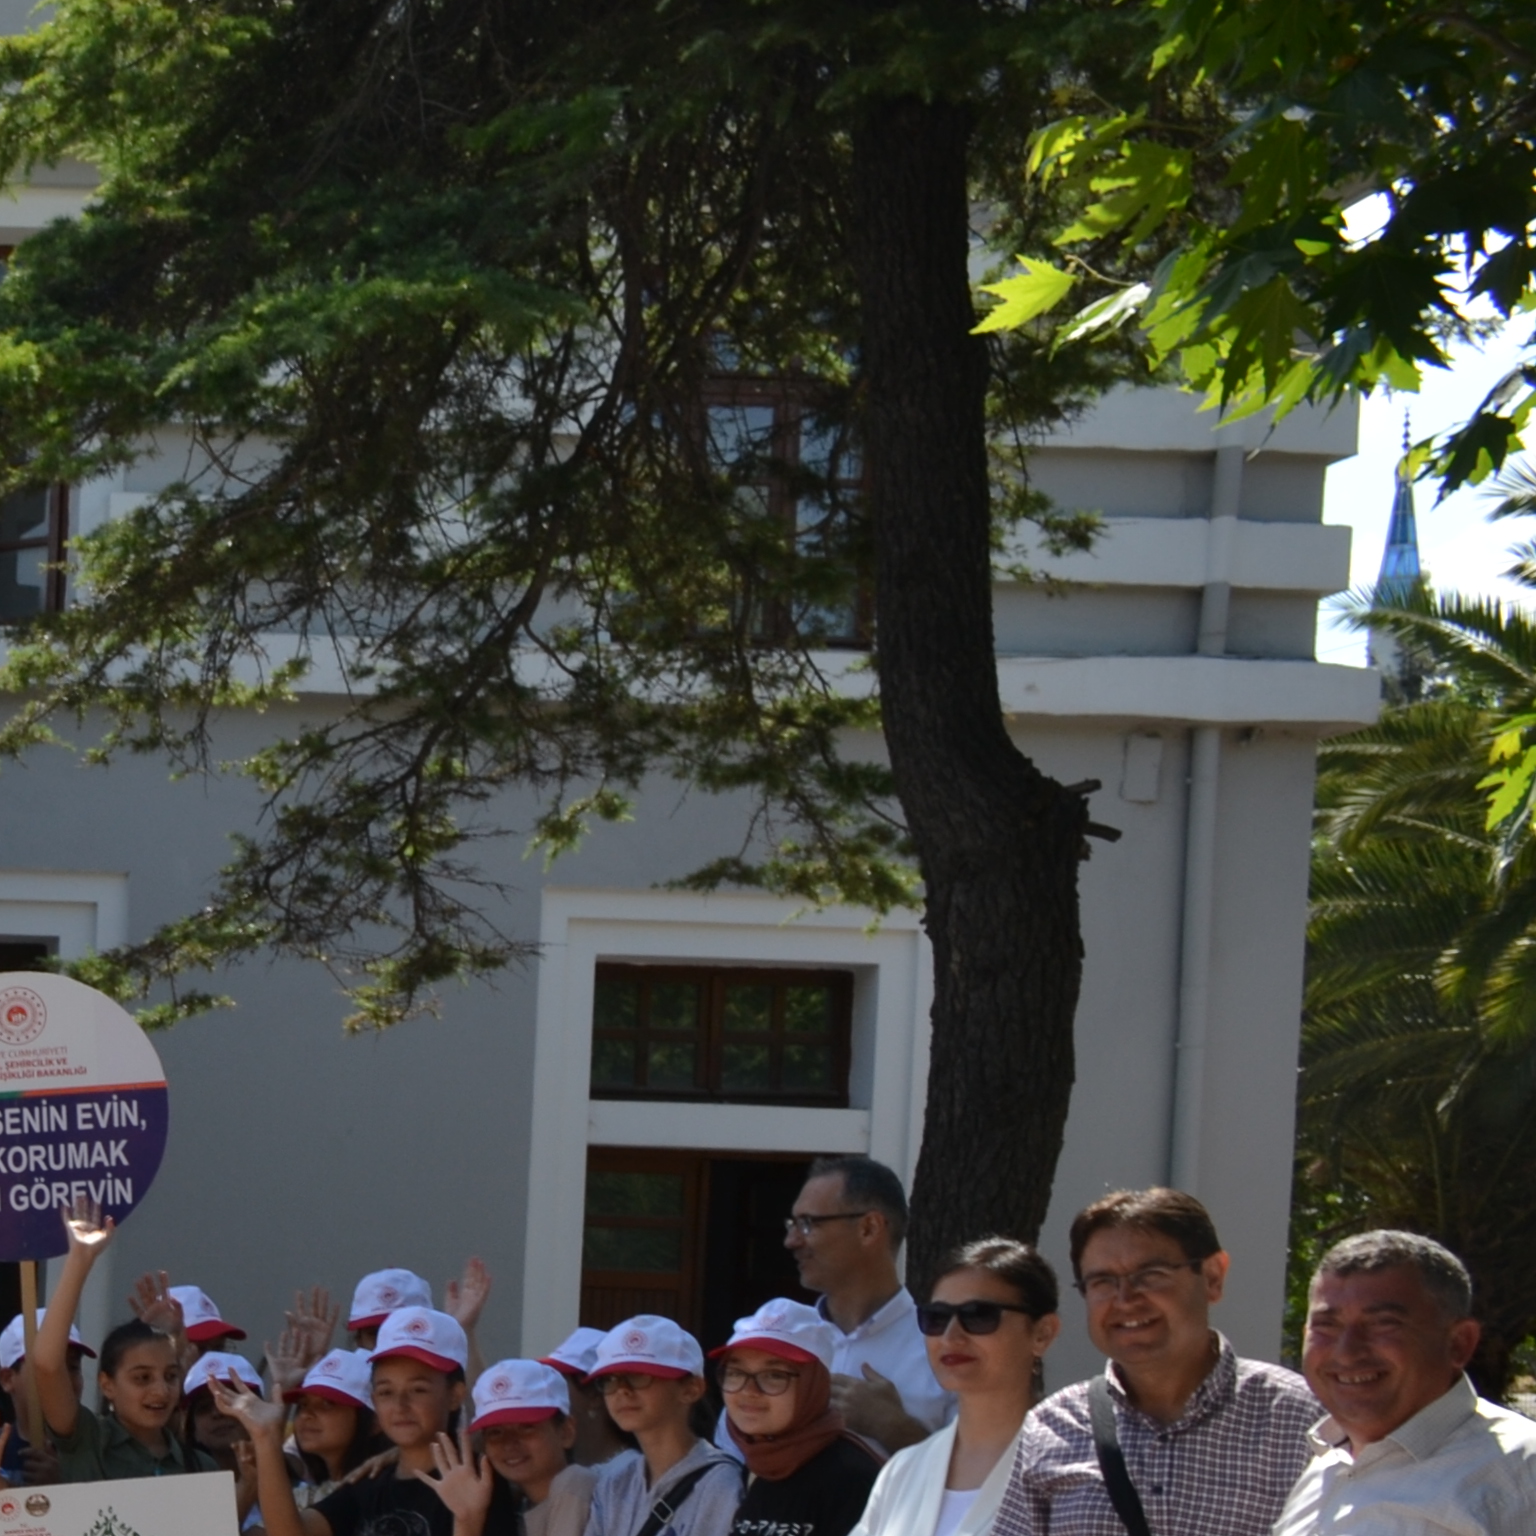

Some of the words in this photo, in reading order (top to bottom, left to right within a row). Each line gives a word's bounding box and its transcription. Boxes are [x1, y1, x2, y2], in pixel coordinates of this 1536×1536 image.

[5, 1058, 54, 1071] ŞEHİRCİLİK
[57, 1058, 68, 1067] VE
[37, 1066, 87, 1078] BAKANLIĞI
[76, 1094, 147, 1131] EVİN,
[9, 1172, 133, 1212] GÖREVİN
